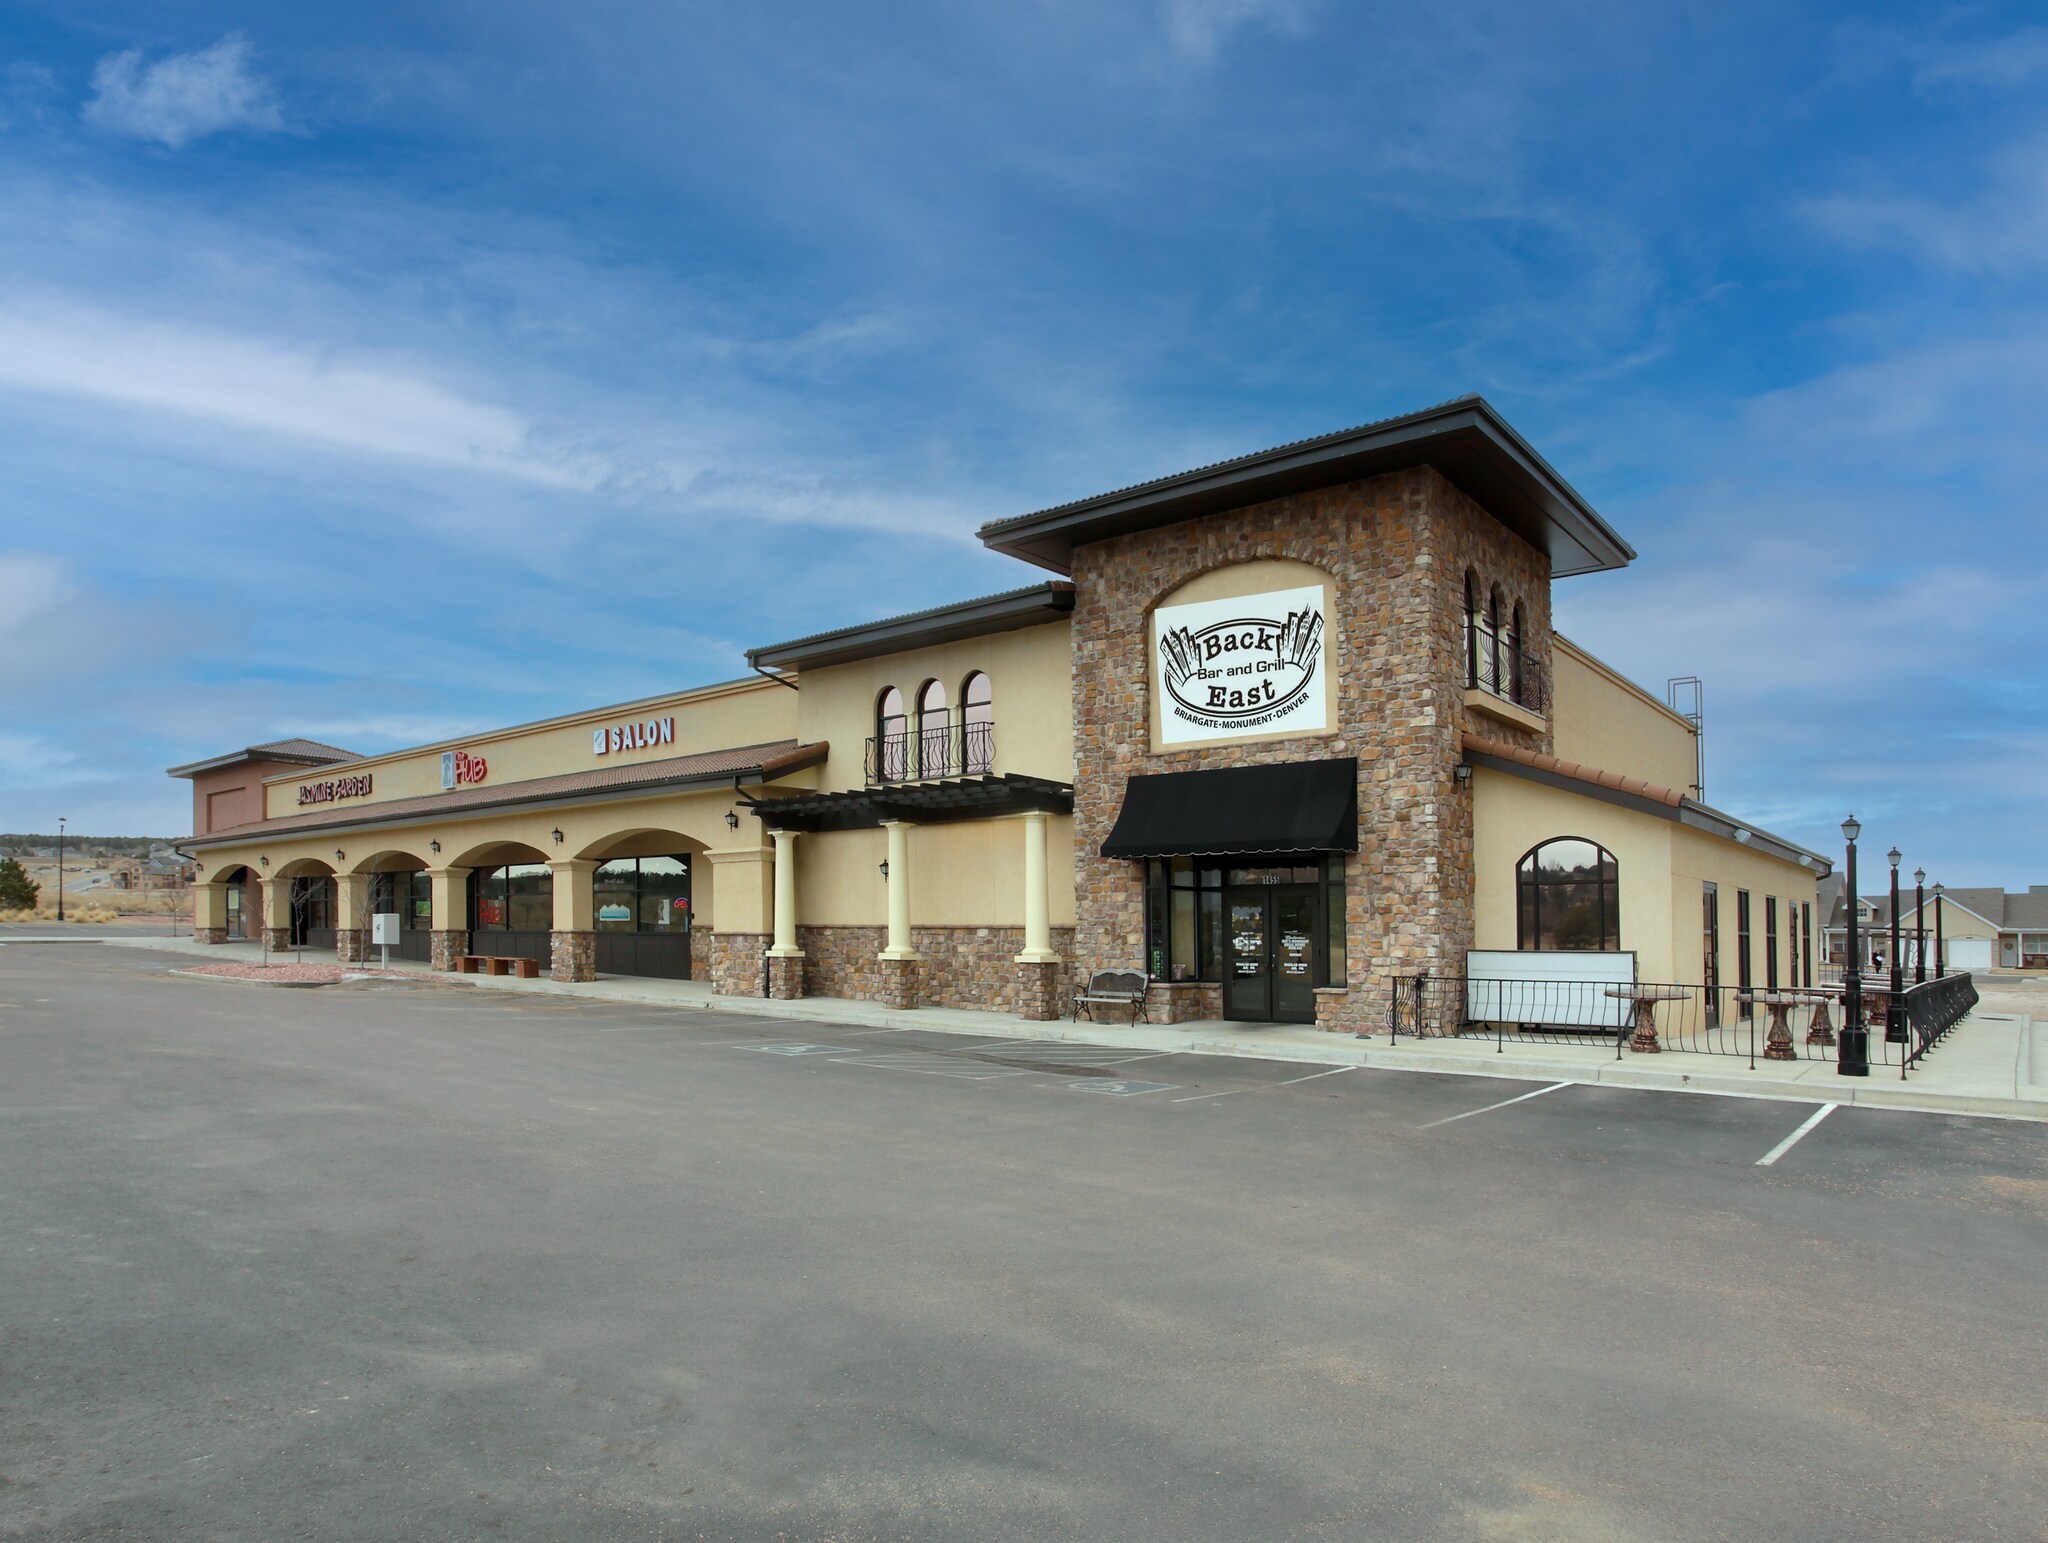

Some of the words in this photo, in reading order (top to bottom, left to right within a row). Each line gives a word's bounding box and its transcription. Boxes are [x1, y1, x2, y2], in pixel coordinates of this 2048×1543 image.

[1203, 628, 1275, 661] Back
[1197, 669, 1223, 680] Bar
[1227, 662, 1252, 676] and
[1256, 658, 1285, 672] Grill
[1206, 679, 1275, 708] East
[612, 717, 675, 752] SALON
